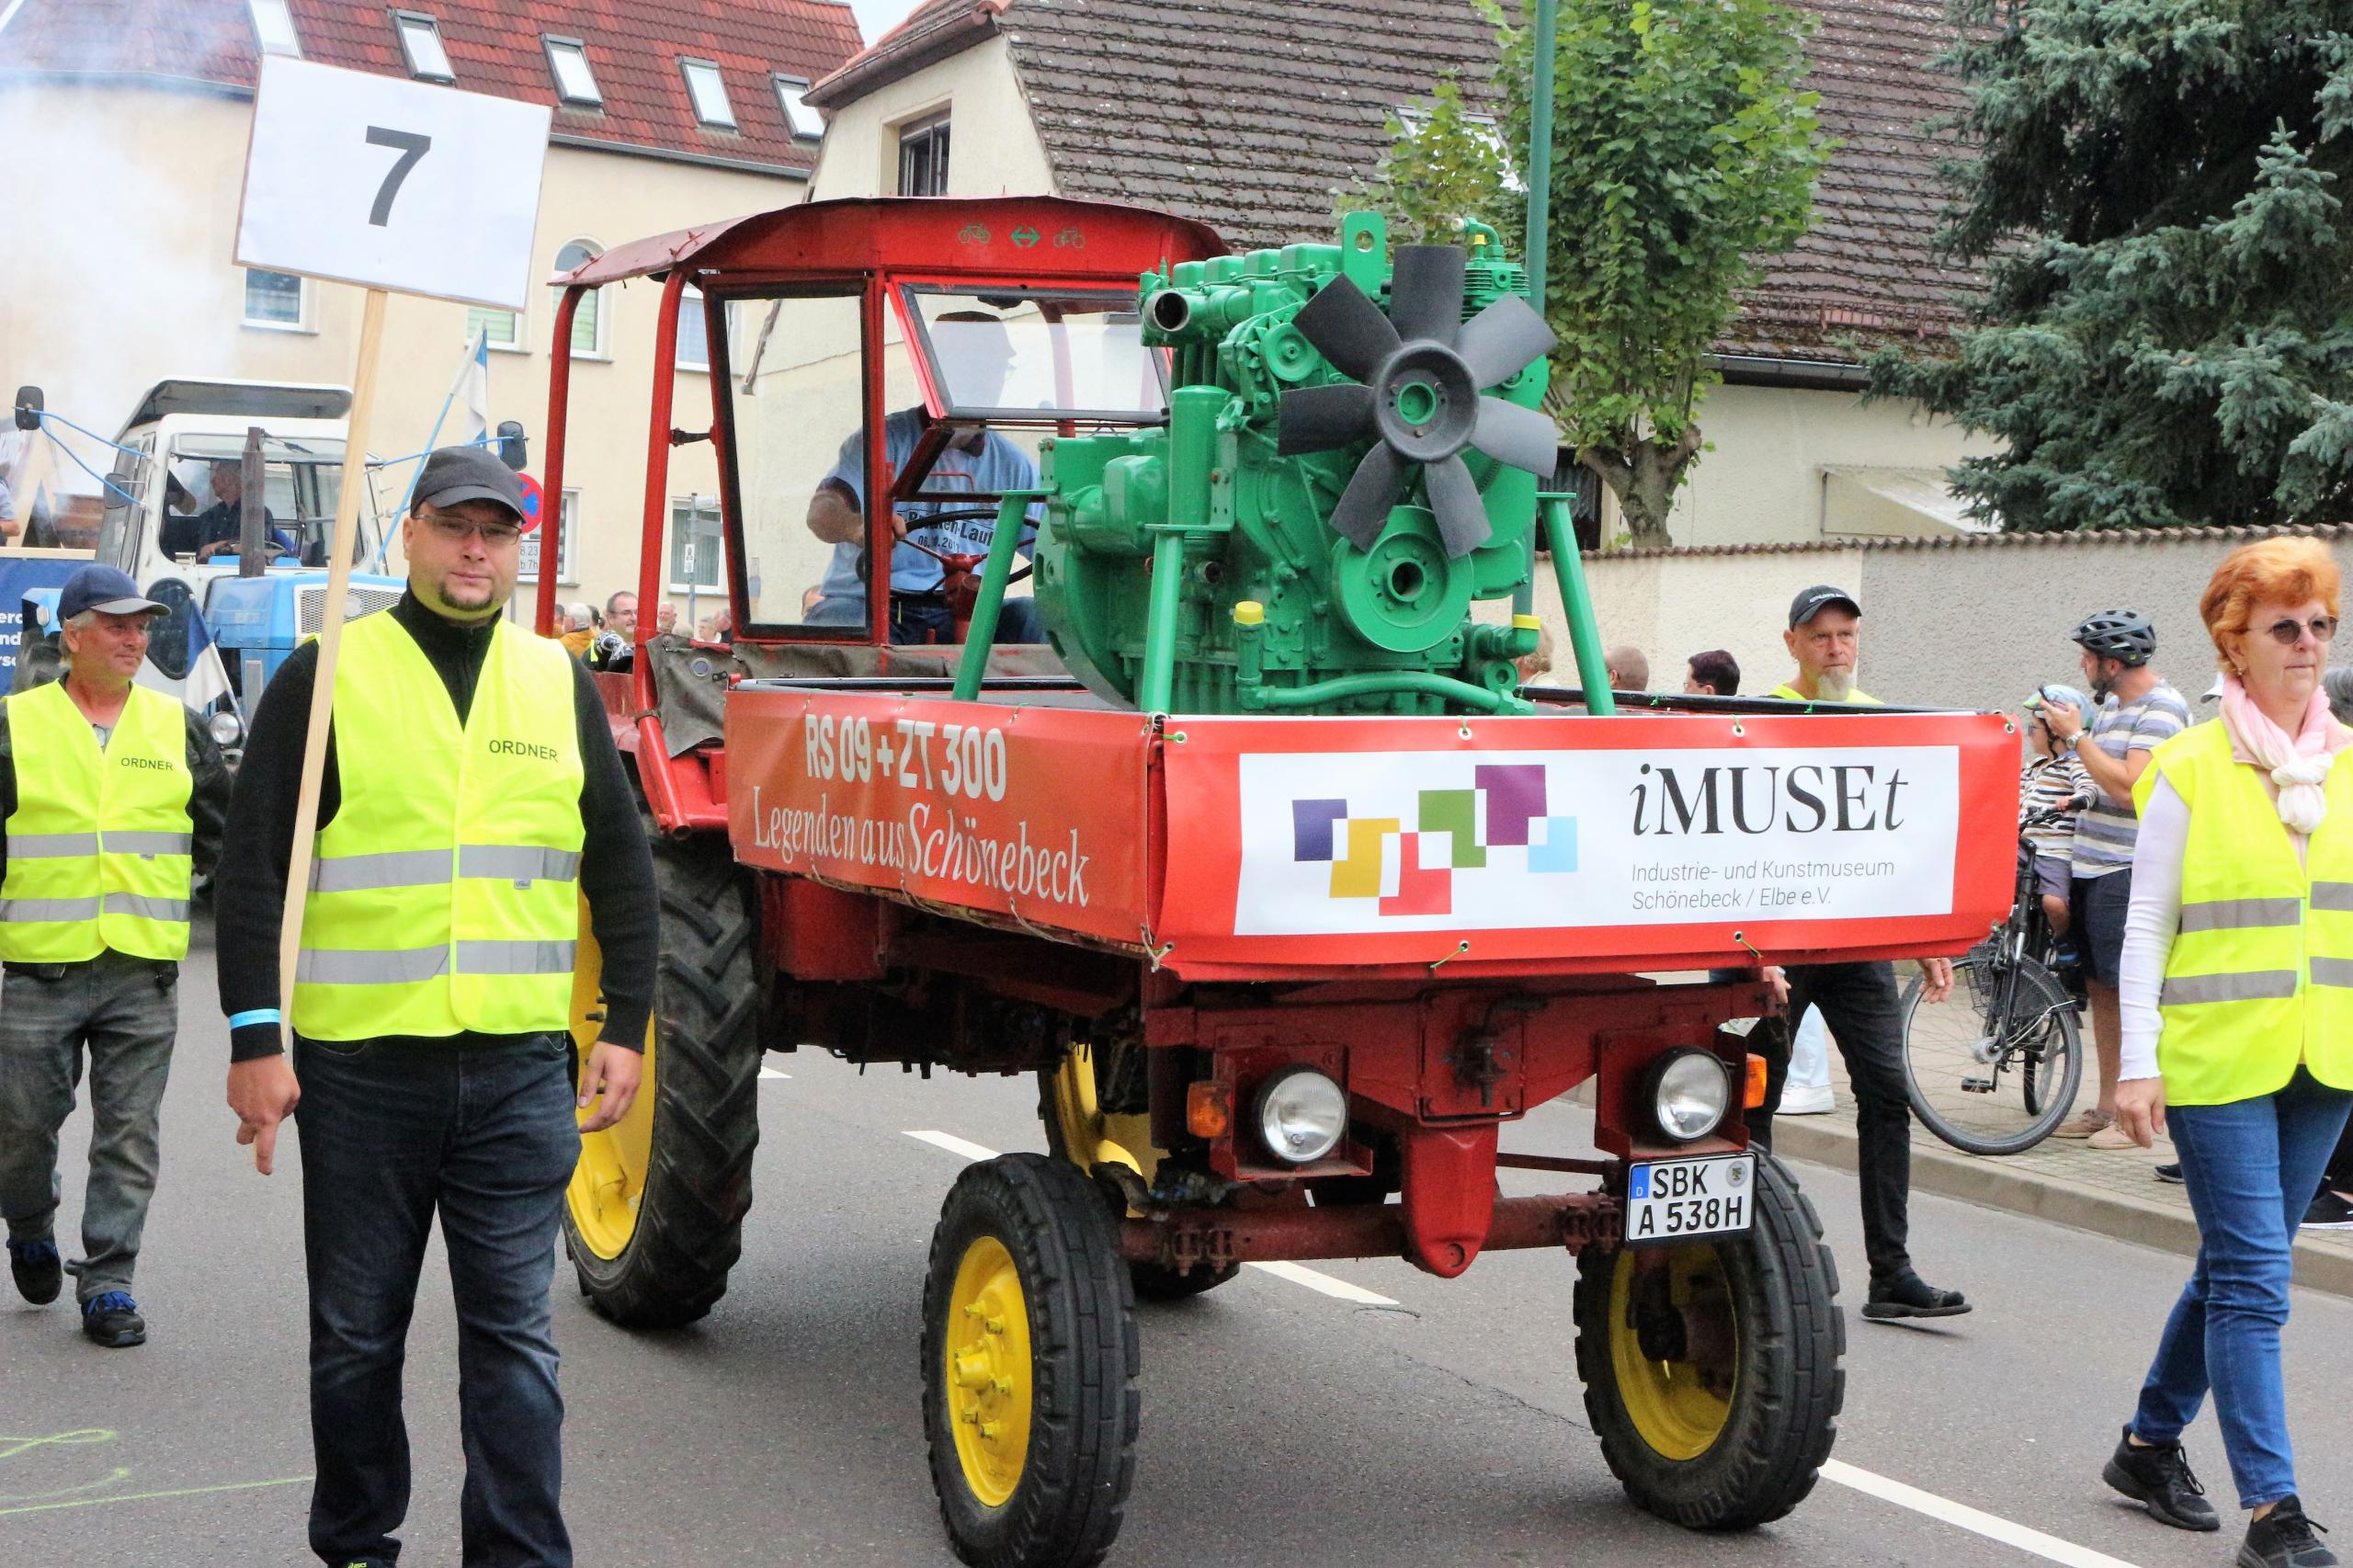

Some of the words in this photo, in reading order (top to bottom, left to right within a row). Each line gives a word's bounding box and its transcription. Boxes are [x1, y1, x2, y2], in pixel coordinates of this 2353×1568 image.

[366, 125, 432, 227] 7
[120, 757, 173, 770] ORDNER
[489, 739, 559, 763] ORDNER
[805, 713, 835, 779] RS
[840, 715, 871, 783] 09
[897, 719, 937, 790] ZT
[942, 724, 1006, 801] 300
[1630, 763, 1909, 835] iMUSEt
[754, 786, 856, 864] Legenden
[859, 817, 906, 869] aus
[908, 801, 1090, 908] Schönebeck
[1631, 861, 1718, 881] Industrie-
[1724, 860, 1756, 880] und
[1762, 860, 1895, 880] Kunstmuseum
[1632, 888, 1742, 910] Schönebeck
[1760, 887, 1797, 906] Elbe
[1801, 886, 1832, 905] e.V.
[1653, 1165, 1709, 1199] SBK
[1639, 1205, 1654, 1235] A
[1666, 1196, 1743, 1233] 538H
